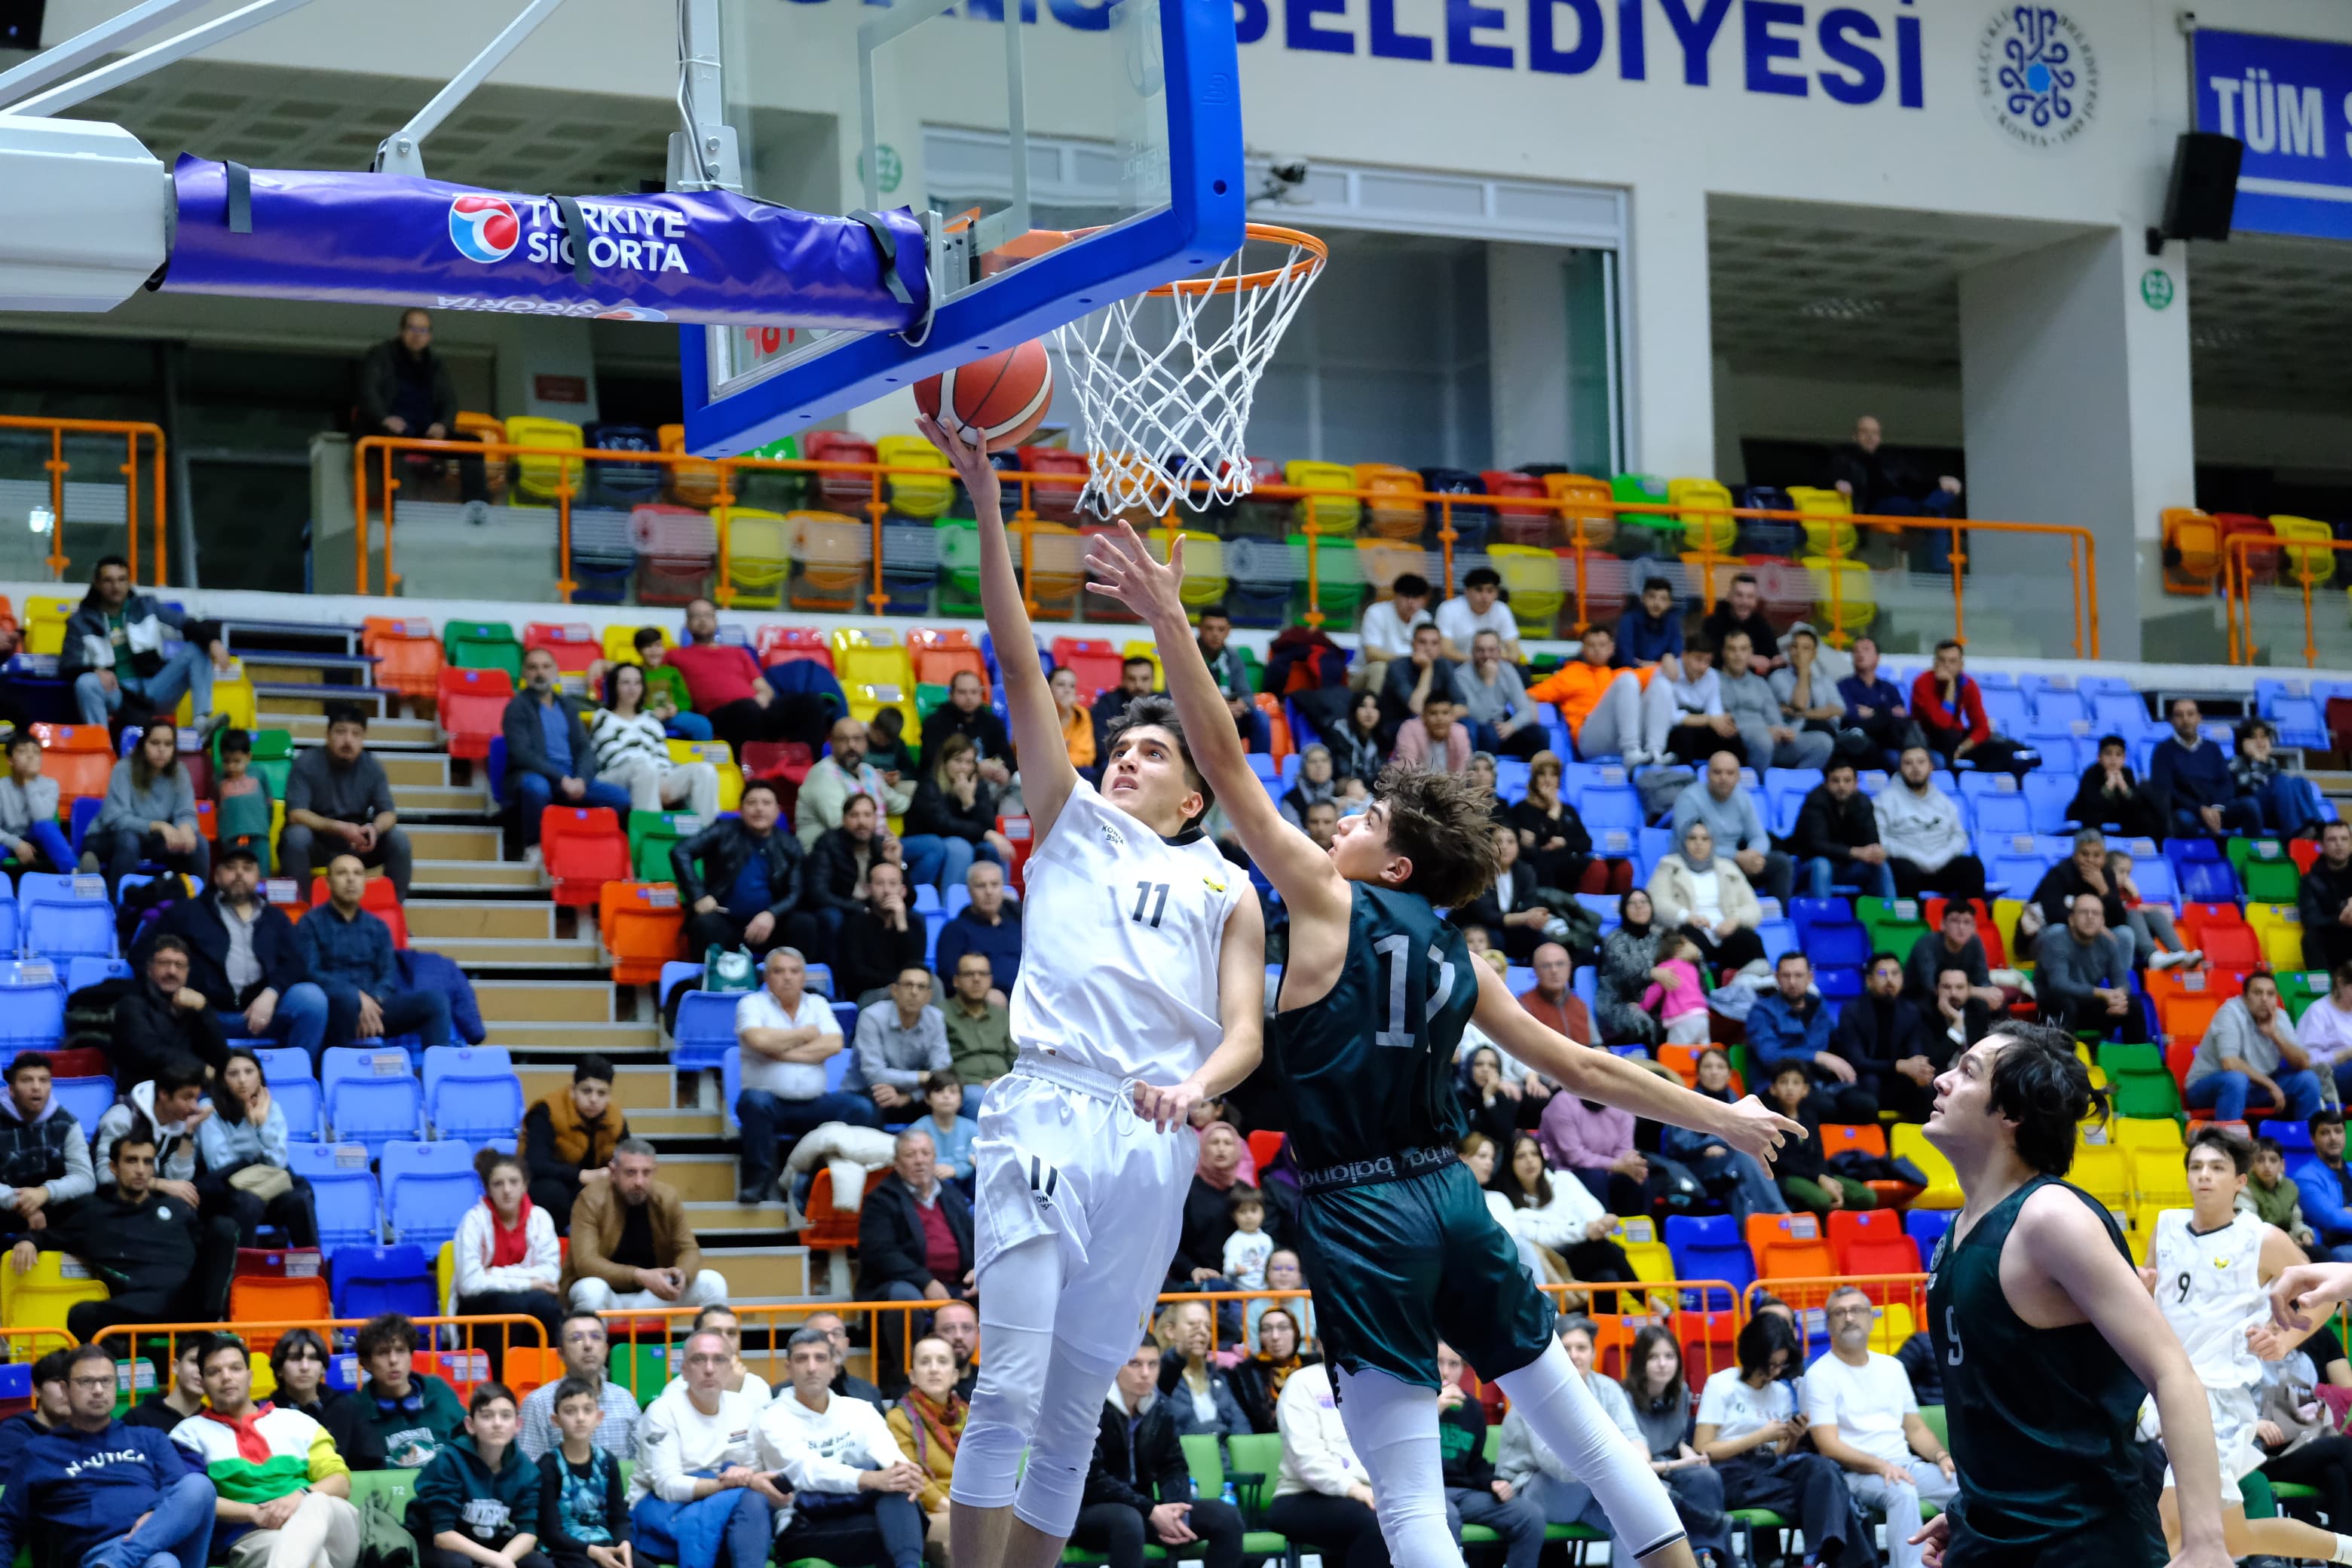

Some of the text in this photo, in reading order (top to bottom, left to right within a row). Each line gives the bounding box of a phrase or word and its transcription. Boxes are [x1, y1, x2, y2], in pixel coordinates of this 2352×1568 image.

[2210, 67, 2326, 159] TÜM
[1132, 880, 1170, 928] 11
[2177, 1271, 2191, 1303] 9
[1946, 1305, 1964, 1366] 9
[65, 1449, 145, 1478] NAUTICA
